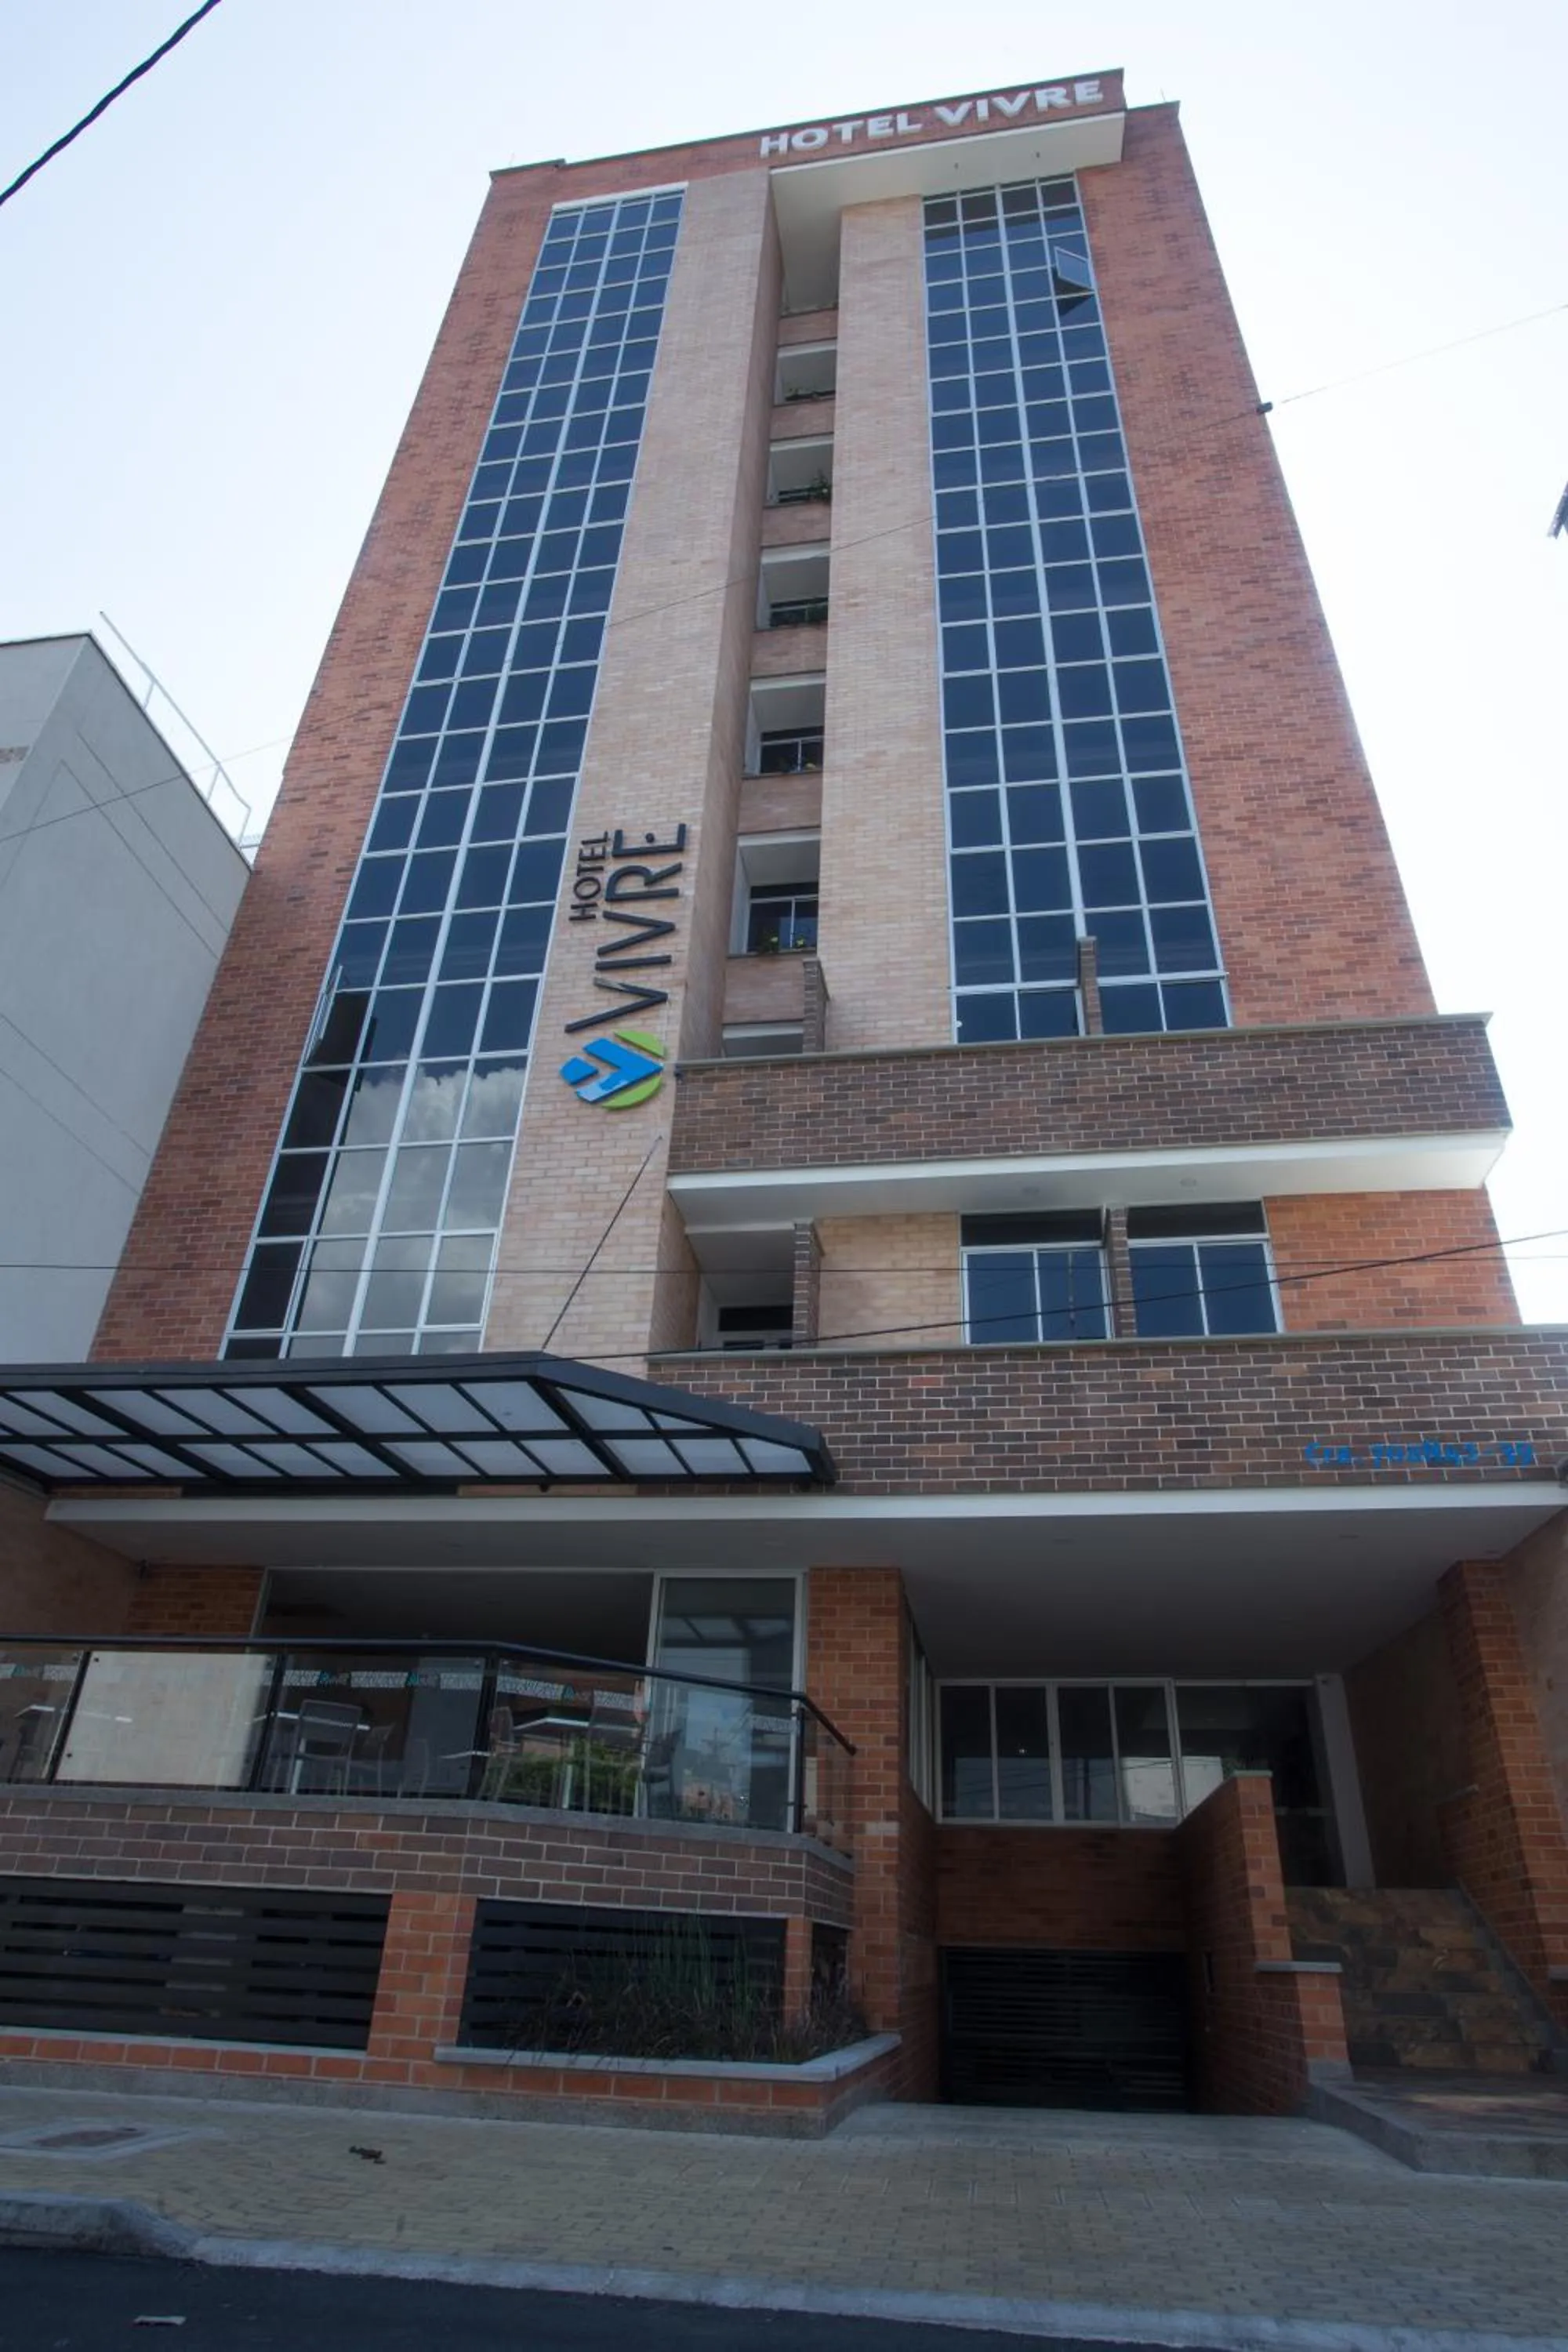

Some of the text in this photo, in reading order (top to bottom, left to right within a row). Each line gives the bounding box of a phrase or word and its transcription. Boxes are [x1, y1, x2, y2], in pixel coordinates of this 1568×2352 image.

[758, 79, 1104, 158] HOTEL VIVRE
[568, 830, 612, 921] HOTEL
[564, 822, 687, 1034] VIVRE
